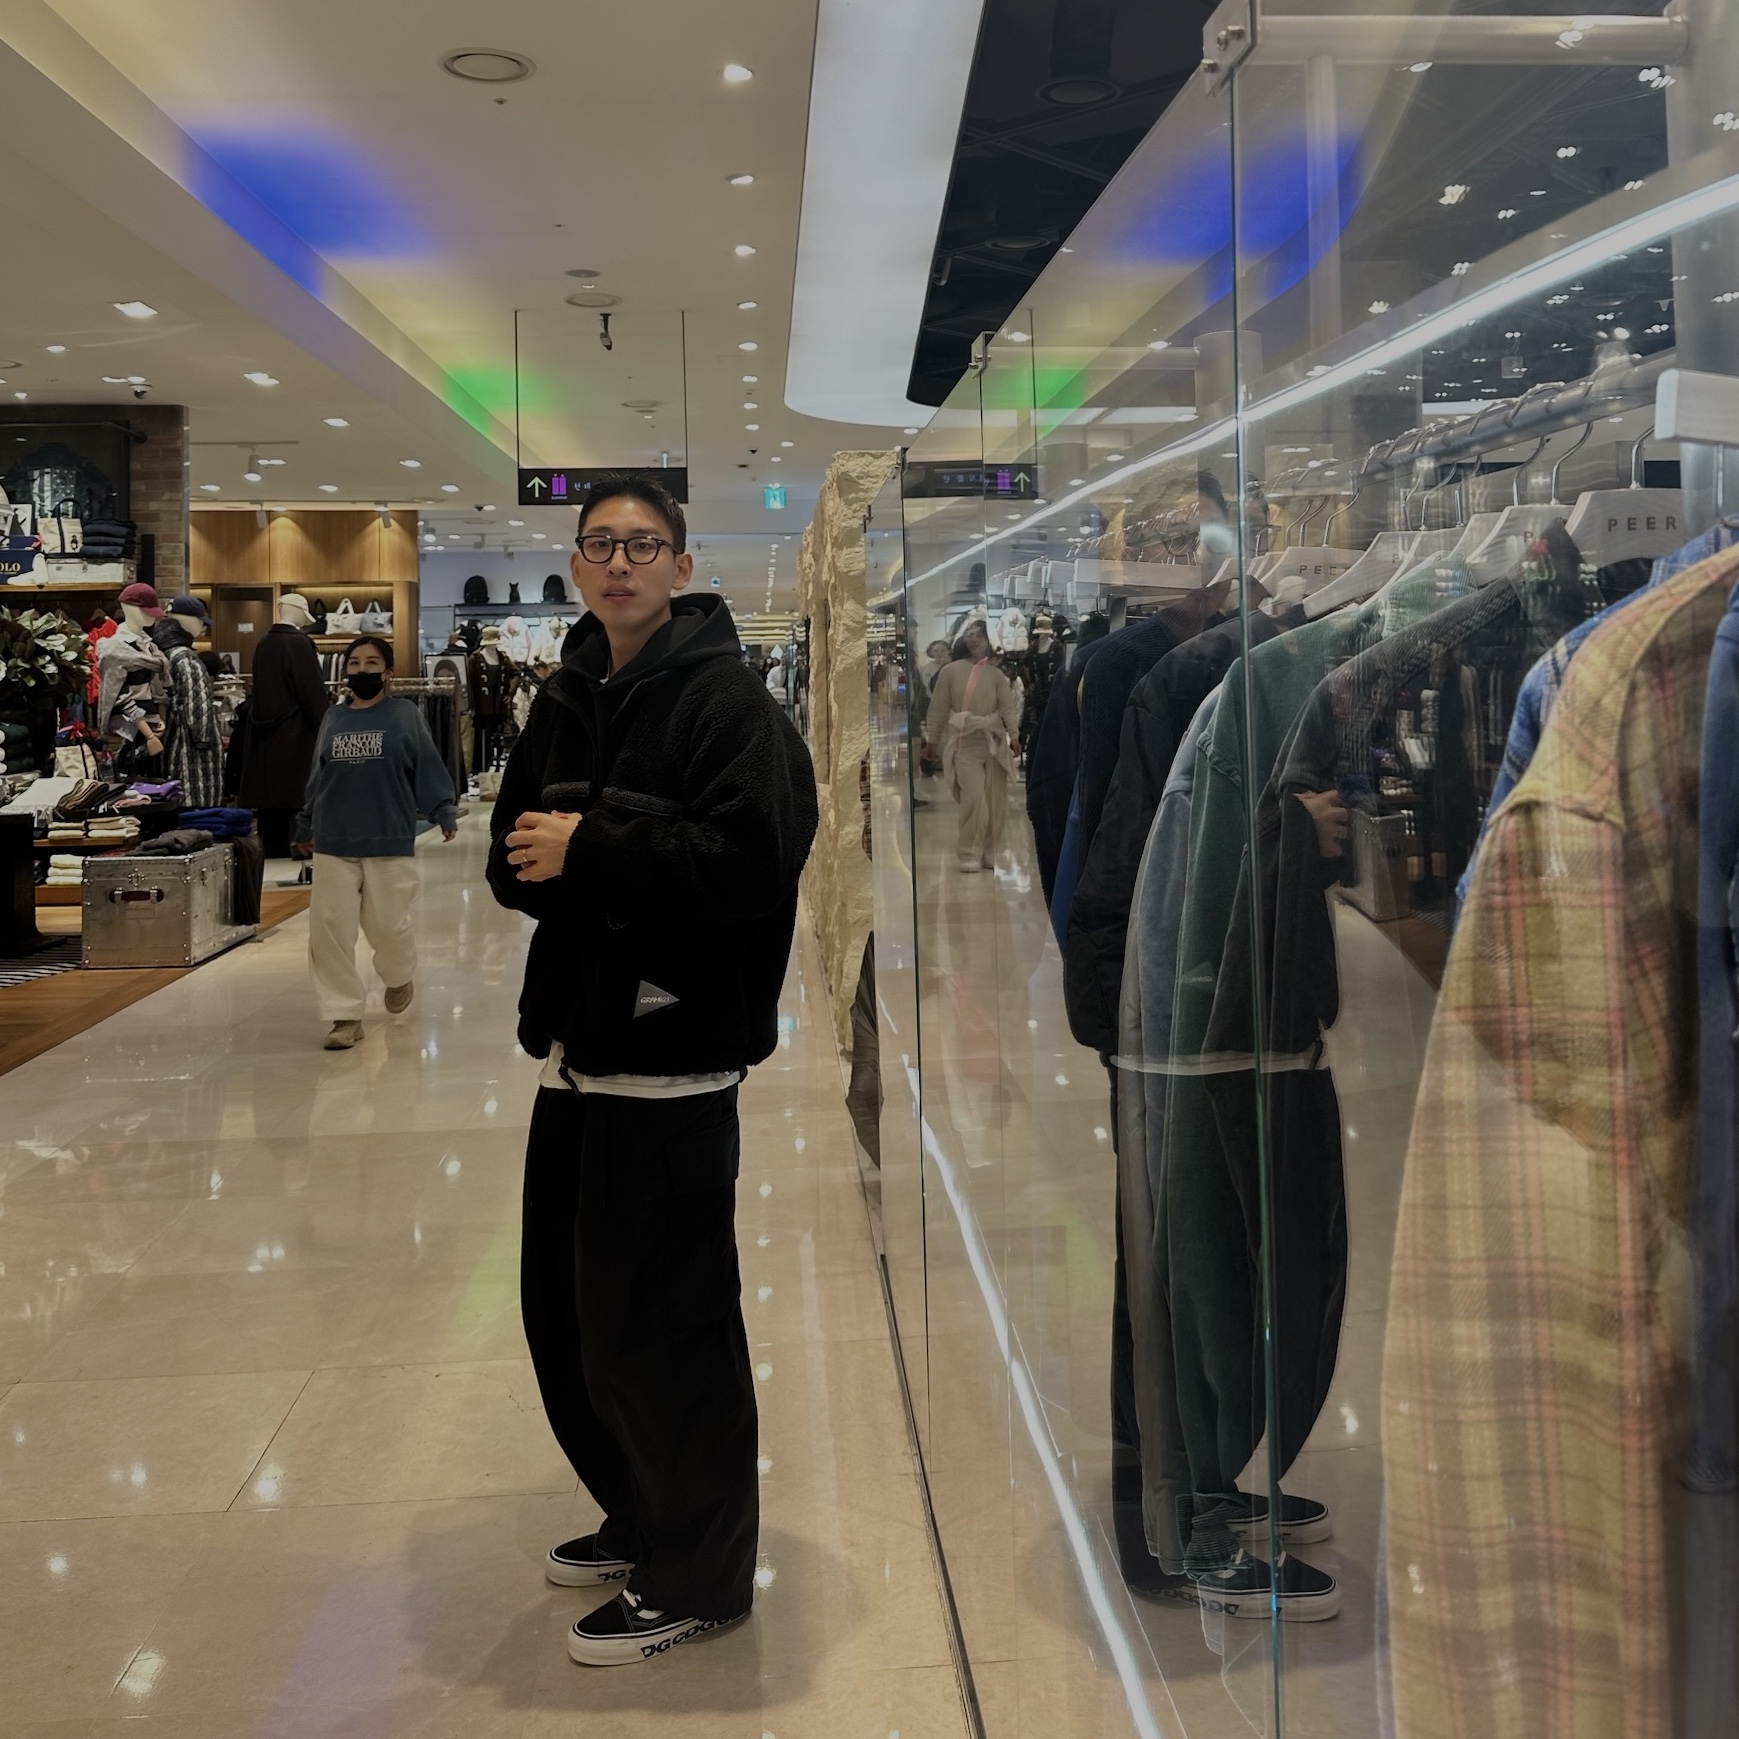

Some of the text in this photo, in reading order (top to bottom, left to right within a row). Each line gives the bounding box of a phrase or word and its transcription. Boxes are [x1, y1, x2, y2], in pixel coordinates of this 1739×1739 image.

[1607, 516, 1677, 532] PEER
[1298, 564, 1352, 577] PEE
[331, 746, 383, 758] GIRBAUD
